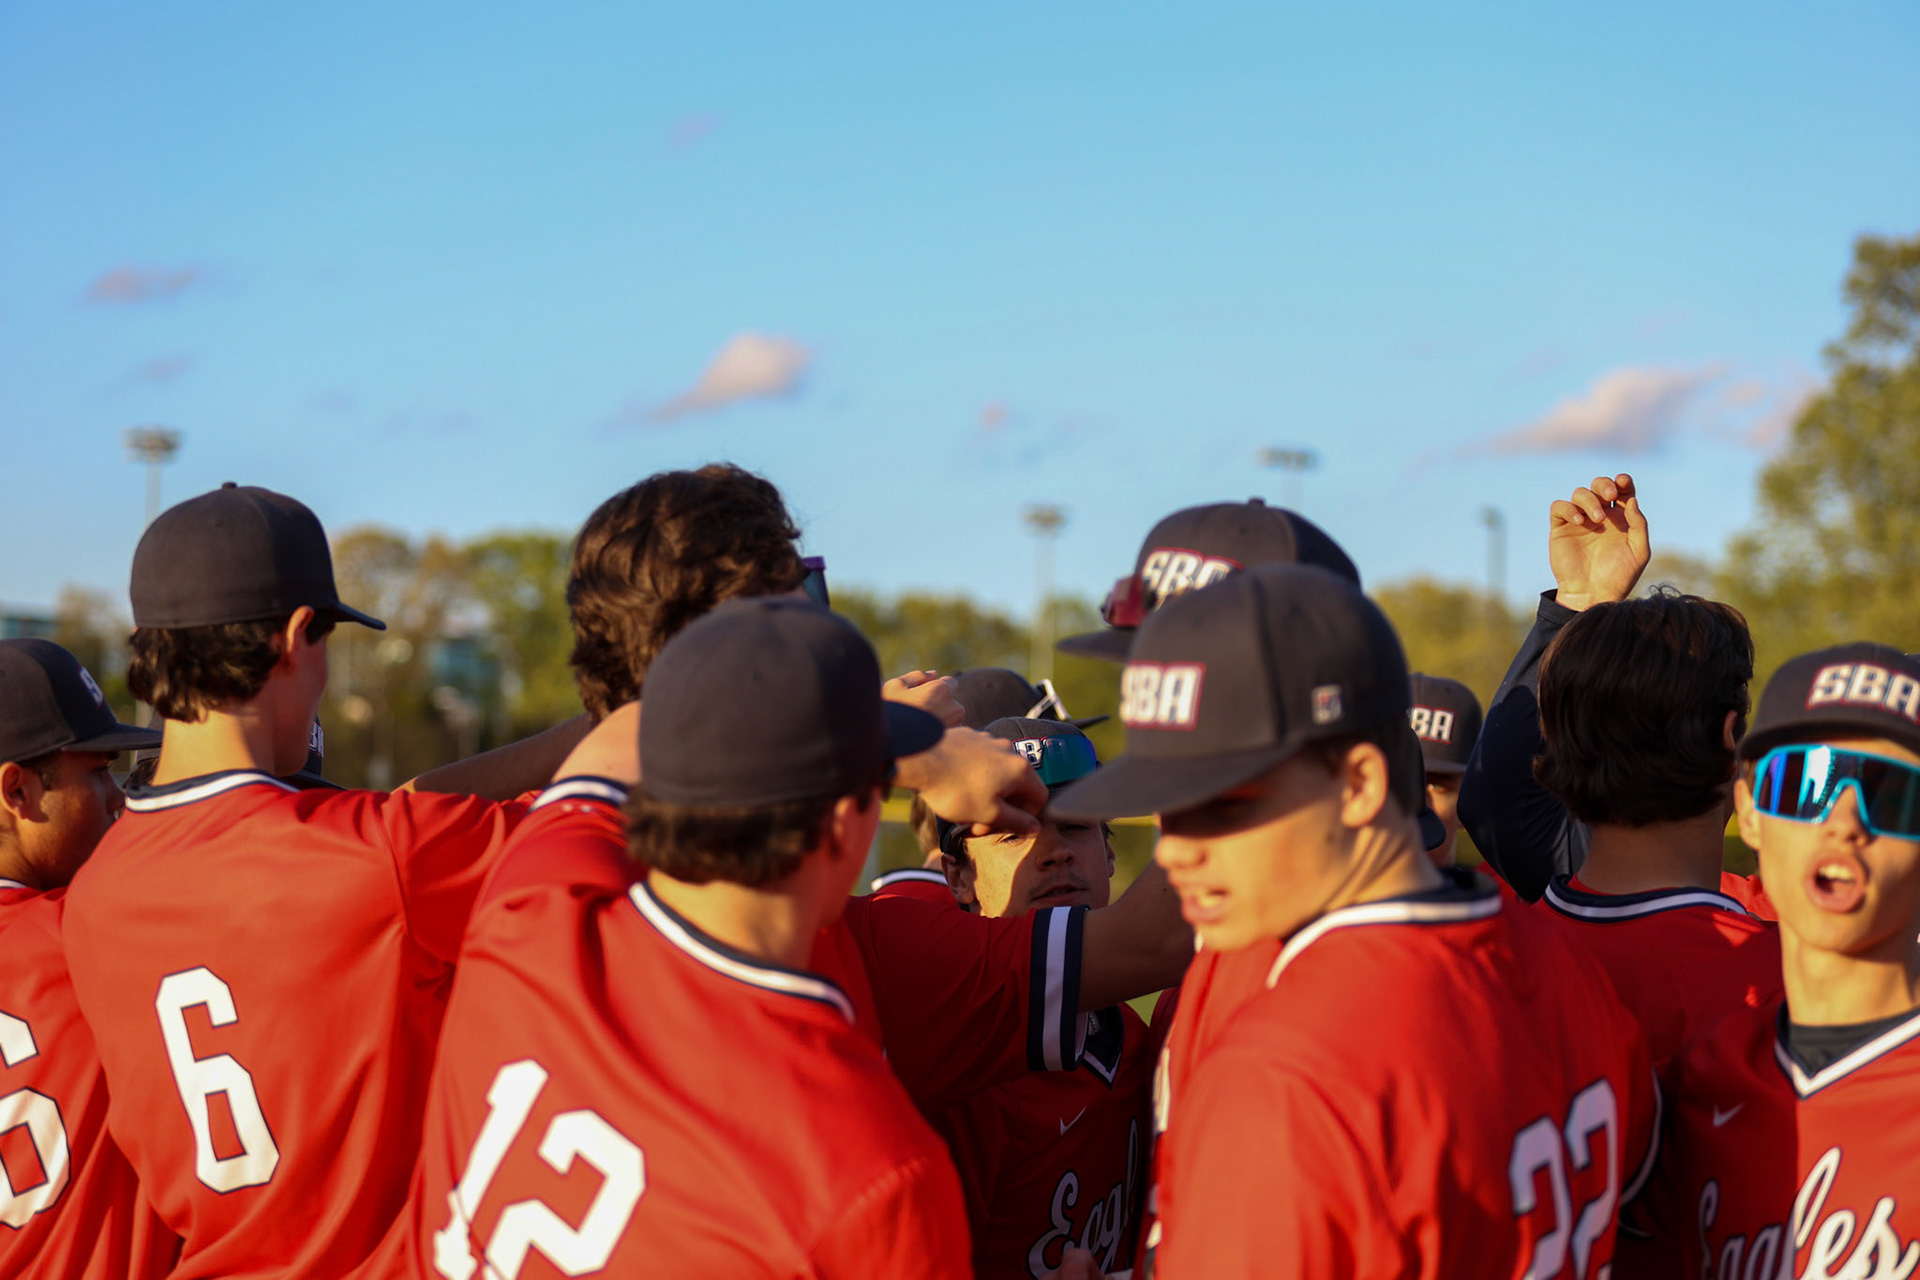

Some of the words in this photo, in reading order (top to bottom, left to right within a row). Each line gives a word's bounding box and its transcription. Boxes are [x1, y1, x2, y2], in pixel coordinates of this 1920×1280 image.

[1409, 705, 1455, 742] BA
[155, 965, 281, 1195] 6
[434, 1058, 647, 1280] 12
[1509, 1076, 1619, 1280] 22
